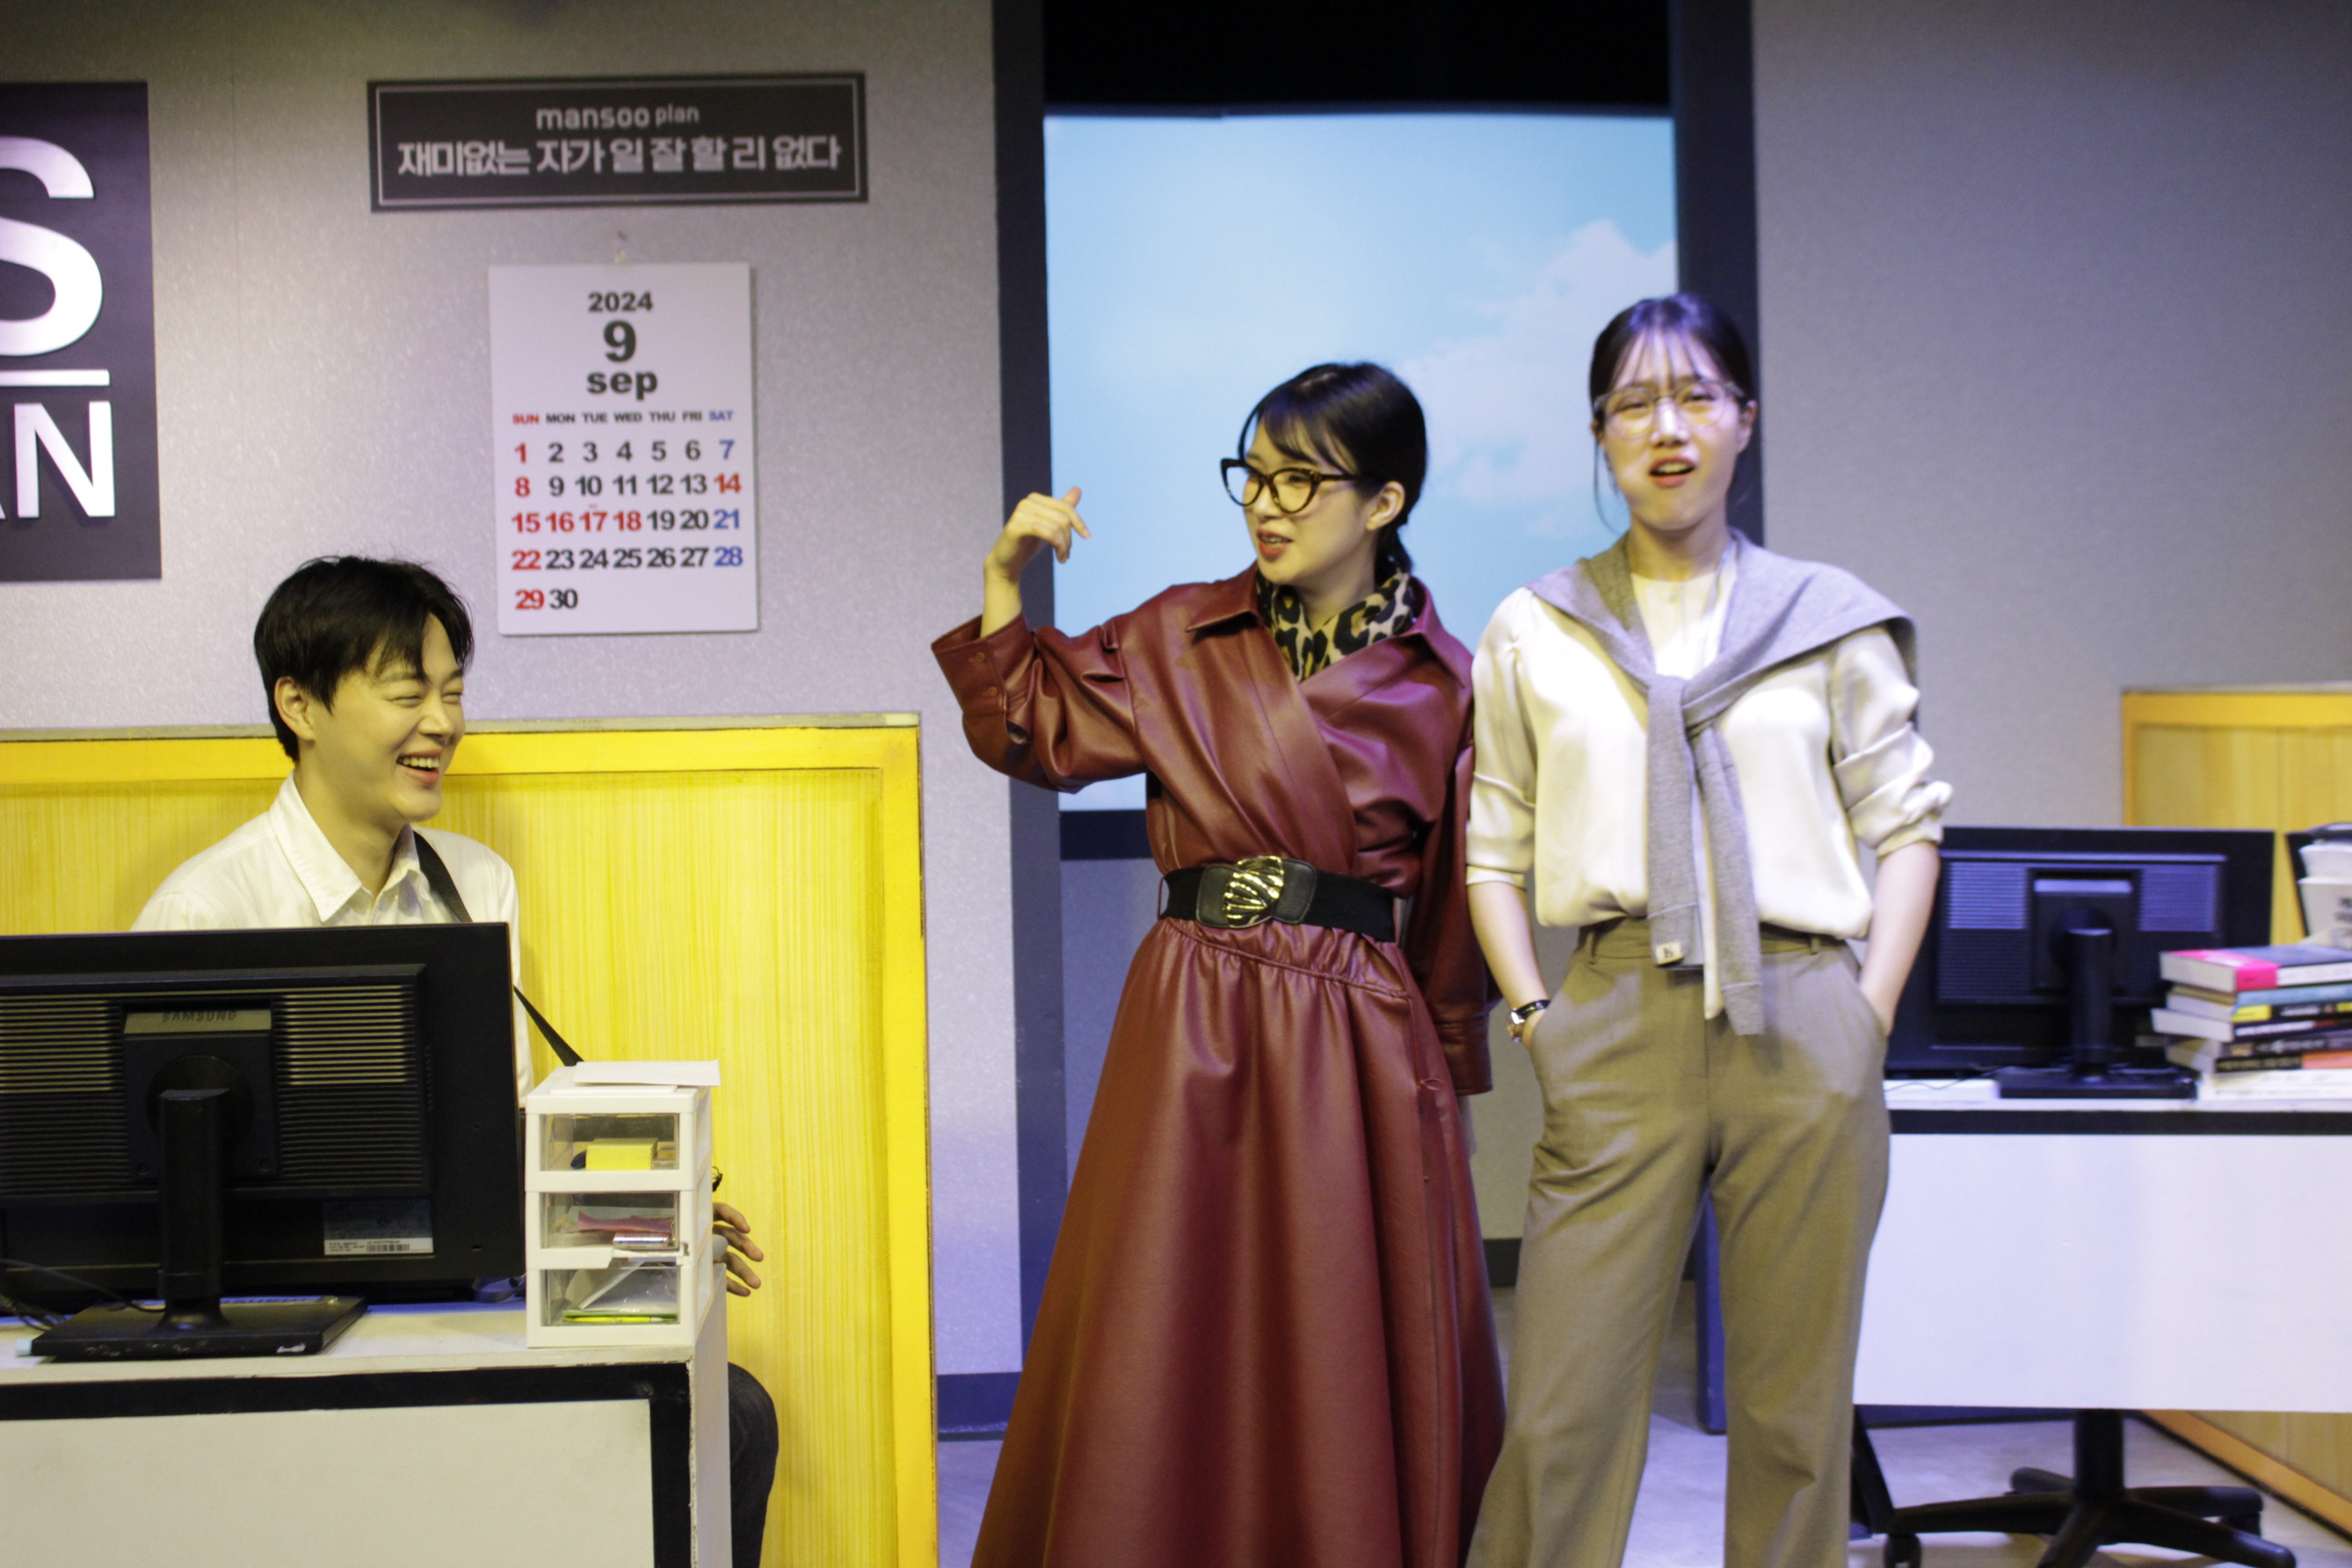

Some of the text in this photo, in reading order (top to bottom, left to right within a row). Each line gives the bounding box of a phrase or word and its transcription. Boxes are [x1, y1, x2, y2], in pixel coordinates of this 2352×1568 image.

[536, 104, 699, 129] mansoo plan
[398, 136, 840, 176] 재미없는 자가 일 잘 할 리 없다
[588, 291, 653, 313] 2024
[603, 319, 637, 364] 9
[586, 371, 659, 401] sep
[513, 410, 733, 425] SUN MON TUE WED THU FRI SAT
[0, 401, 115, 518] N
[514, 438, 735, 464] 1 2 3 4 5 6 7
[514, 473, 742, 497] 8 9 10 11 12 13 14
[512, 508, 740, 534] 15 16 17 18 19 20 21
[512, 545, 744, 571] 22 23 24 25 26 27 28
[515, 588, 579, 610] 29 30
[162, 1011, 237, 1023] SAMSUNG
